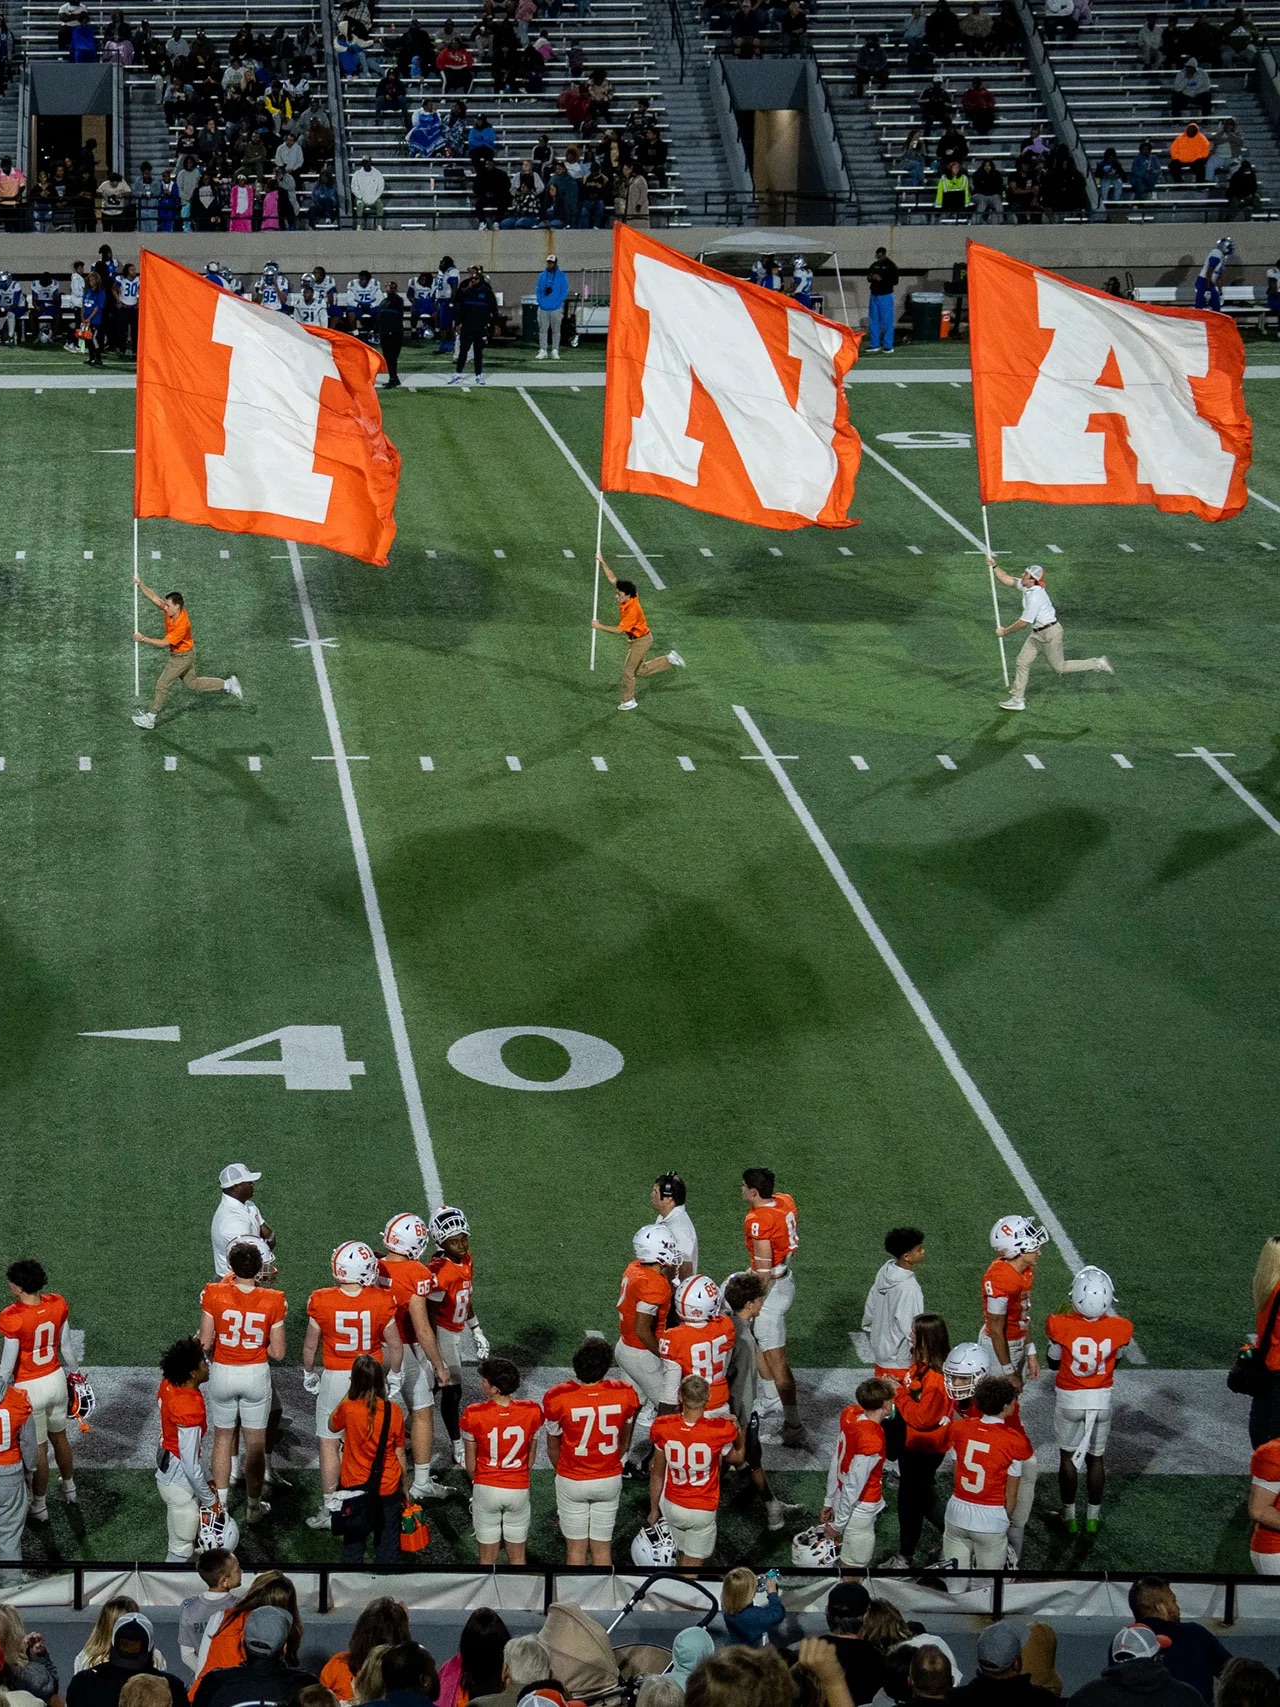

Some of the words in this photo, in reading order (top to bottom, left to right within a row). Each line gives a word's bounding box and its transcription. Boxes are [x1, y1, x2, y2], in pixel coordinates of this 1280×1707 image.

[124, 286, 137, 297] 30
[263, 290, 277, 303] 95
[303, 311, 314, 322] 21
[205, 292, 340, 524] I
[626, 253, 842, 521] N
[1002, 271, 1234, 508] A
[751, 1222, 759, 1237] 8
[704, 1282, 718, 1298] 85
[32, 1320, 55, 1366] 0
[219, 1310, 266, 1349] 35
[335, 1310, 371, 1351] 51
[691, 1335, 728, 1384] 85
[1071, 1337, 1112, 1378] 81
[487, 1425, 525, 1469] 12
[570, 1404, 622, 1457] 75
[665, 1441, 712, 1486] 88
[960, 1440, 990, 1494] 5
